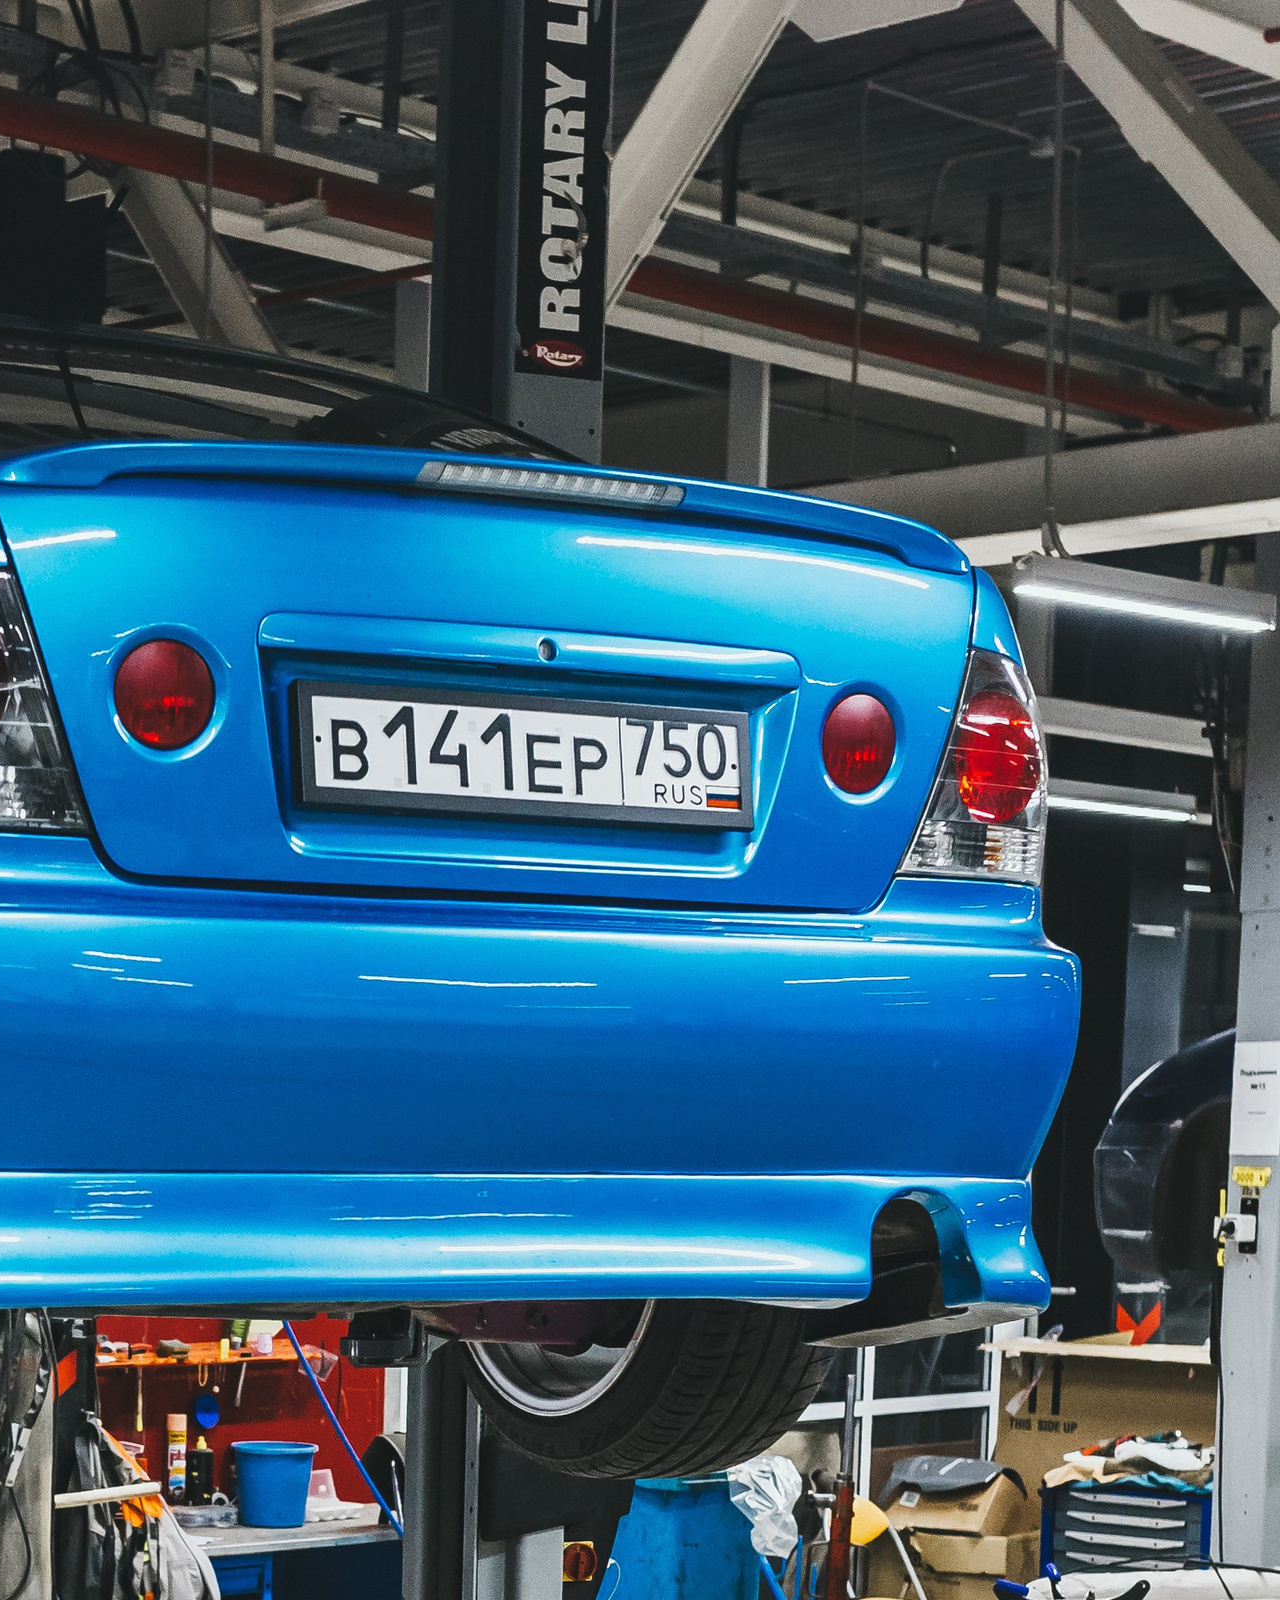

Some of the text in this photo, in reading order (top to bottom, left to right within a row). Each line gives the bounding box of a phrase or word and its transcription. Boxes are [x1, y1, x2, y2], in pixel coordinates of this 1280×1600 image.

[539, 62, 587, 332] ROTARY
[535, 344, 582, 363] Rotary
[626, 717, 727, 780] 750
[654, 783, 703, 805] RUS
[1009, 1417, 1078, 1433] THIS SIDE UP
